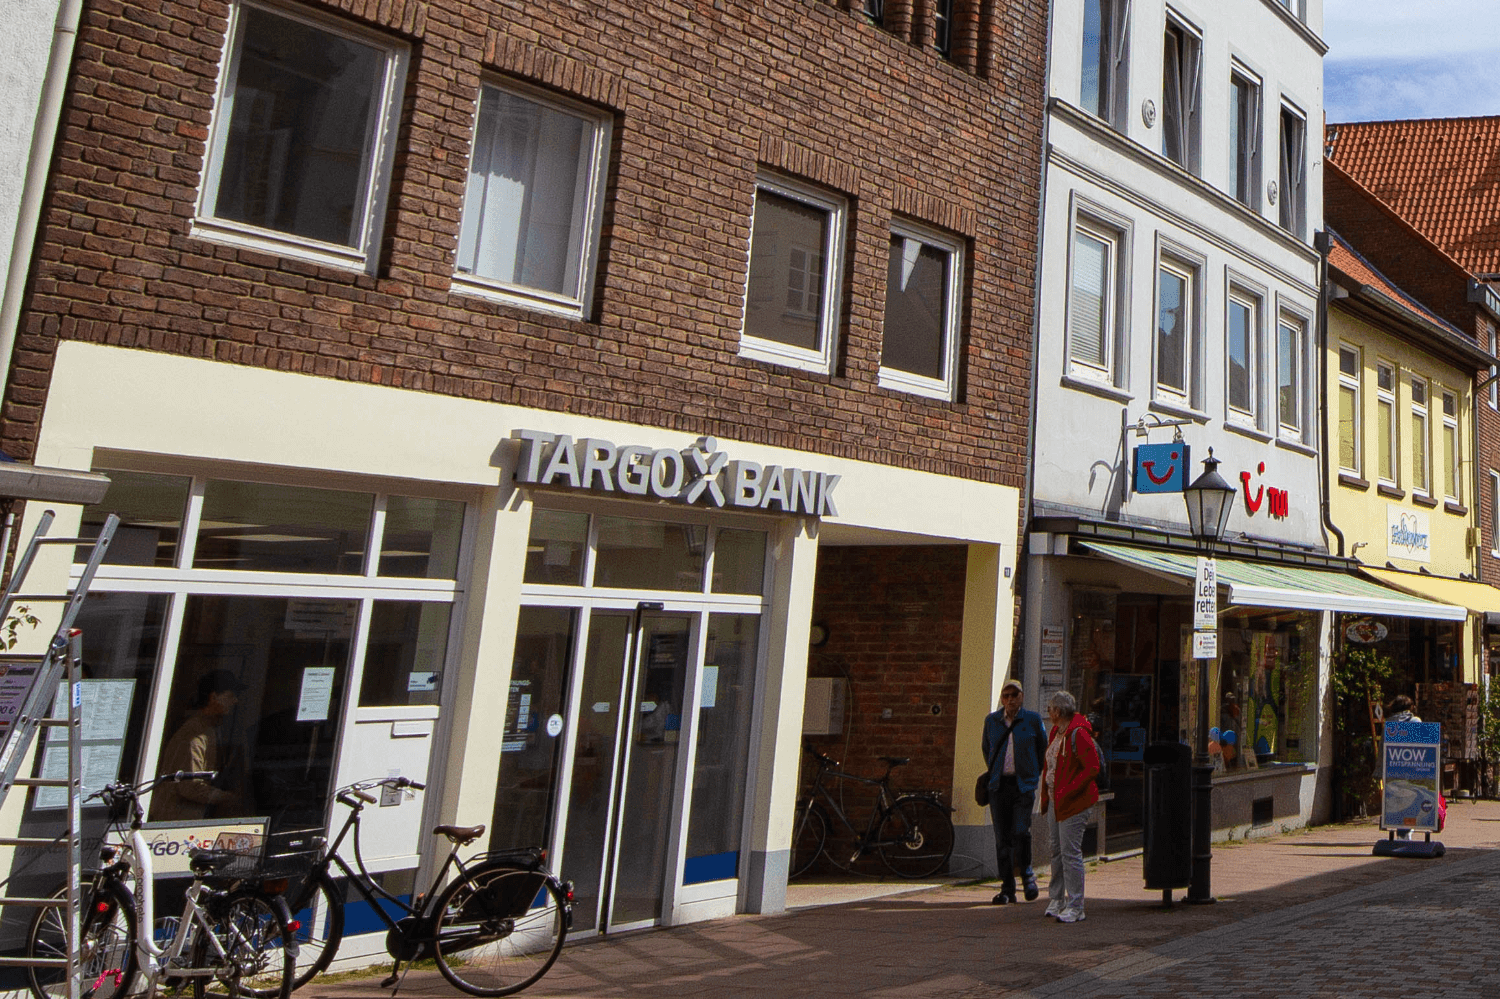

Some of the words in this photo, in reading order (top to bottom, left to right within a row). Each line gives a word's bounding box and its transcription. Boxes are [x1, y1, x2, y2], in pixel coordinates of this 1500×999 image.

[512, 429, 684, 498] TARGO
[730, 460, 842, 517] BANK
[1268, 486, 1289, 518] TUI
[1388, 747, 1427, 762] WOW
[1389, 760, 1436, 768] ENTSPANNUNG
